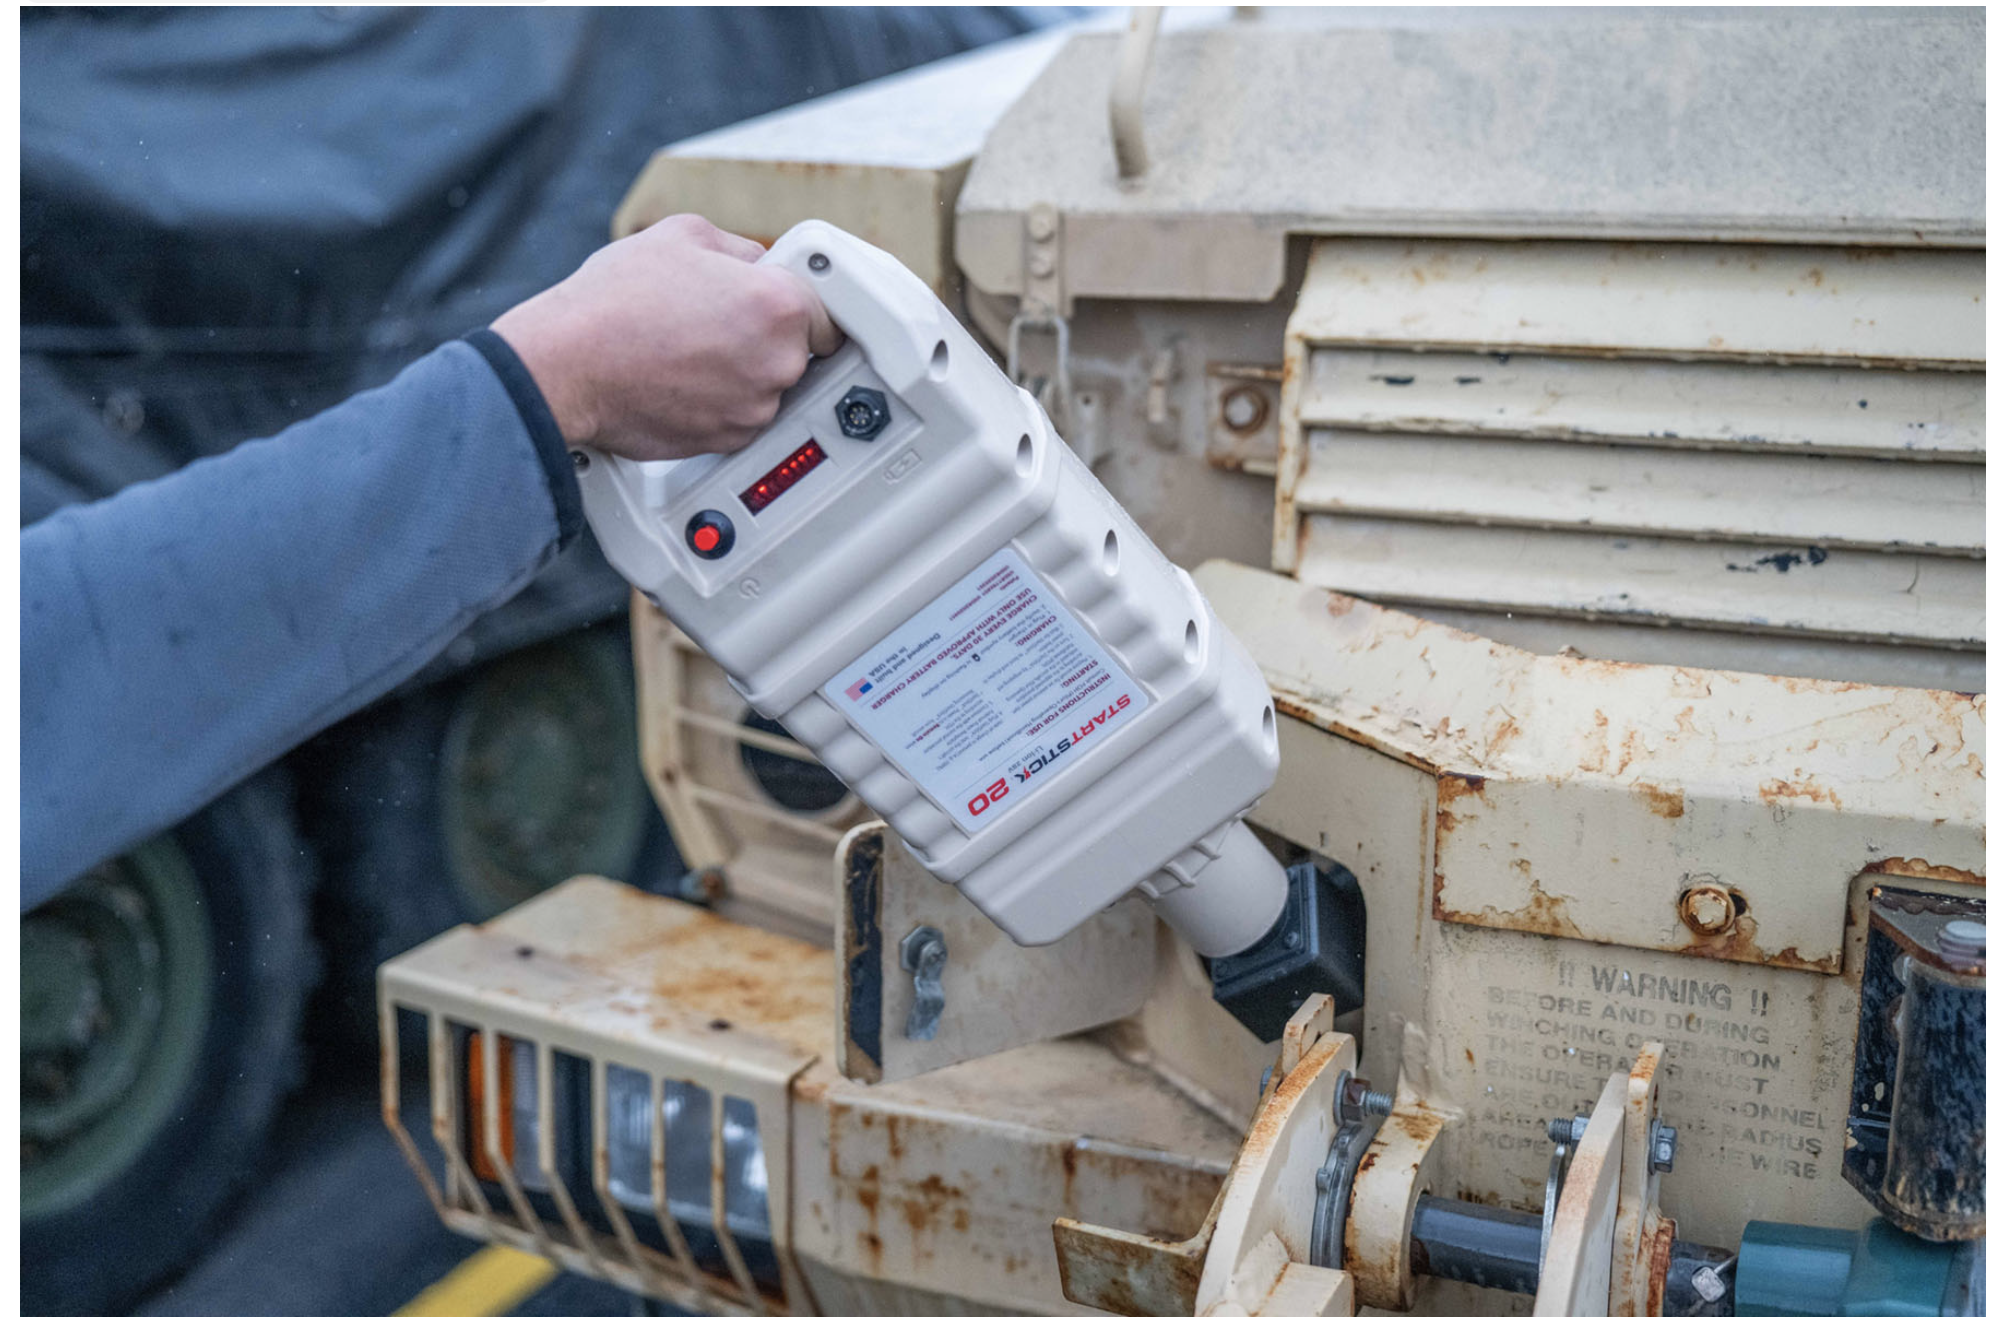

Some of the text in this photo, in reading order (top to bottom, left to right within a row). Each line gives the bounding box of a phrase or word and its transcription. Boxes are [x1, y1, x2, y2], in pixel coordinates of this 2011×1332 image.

[1006, 594, 1037, 618] CHARGE
[1015, 587, 1031, 600] USE
[996, 599, 1016, 616] ONLY
[975, 614, 996, 631] WITH
[983, 617, 1007, 636] EVERY
[1014, 615, 1056, 646] CHARGING:
[874, 632, 941, 683] Designed and built
[885, 653, 898, 663] the
[936, 629, 975, 660] APPROVED
[868, 662, 886, 676] USA
[905, 658, 937, 684] BATTERY
[1060, 659, 1098, 687] STARTING:
[871, 682, 905, 709] CHARGER
[1025, 673, 1110, 735] INSTRUCTIONS FOR USE:
[1013, 693, 1130, 783] STARTSTICK
[967, 777, 1009, 816] 20
[1592, 965, 1732, 1012] WARNING
[1487, 986, 1770, 1045] BEFORE AND DURING
[1485, 1058, 1585, 1090] ENSURE
[1751, 1153, 1818, 1179] WIRE
